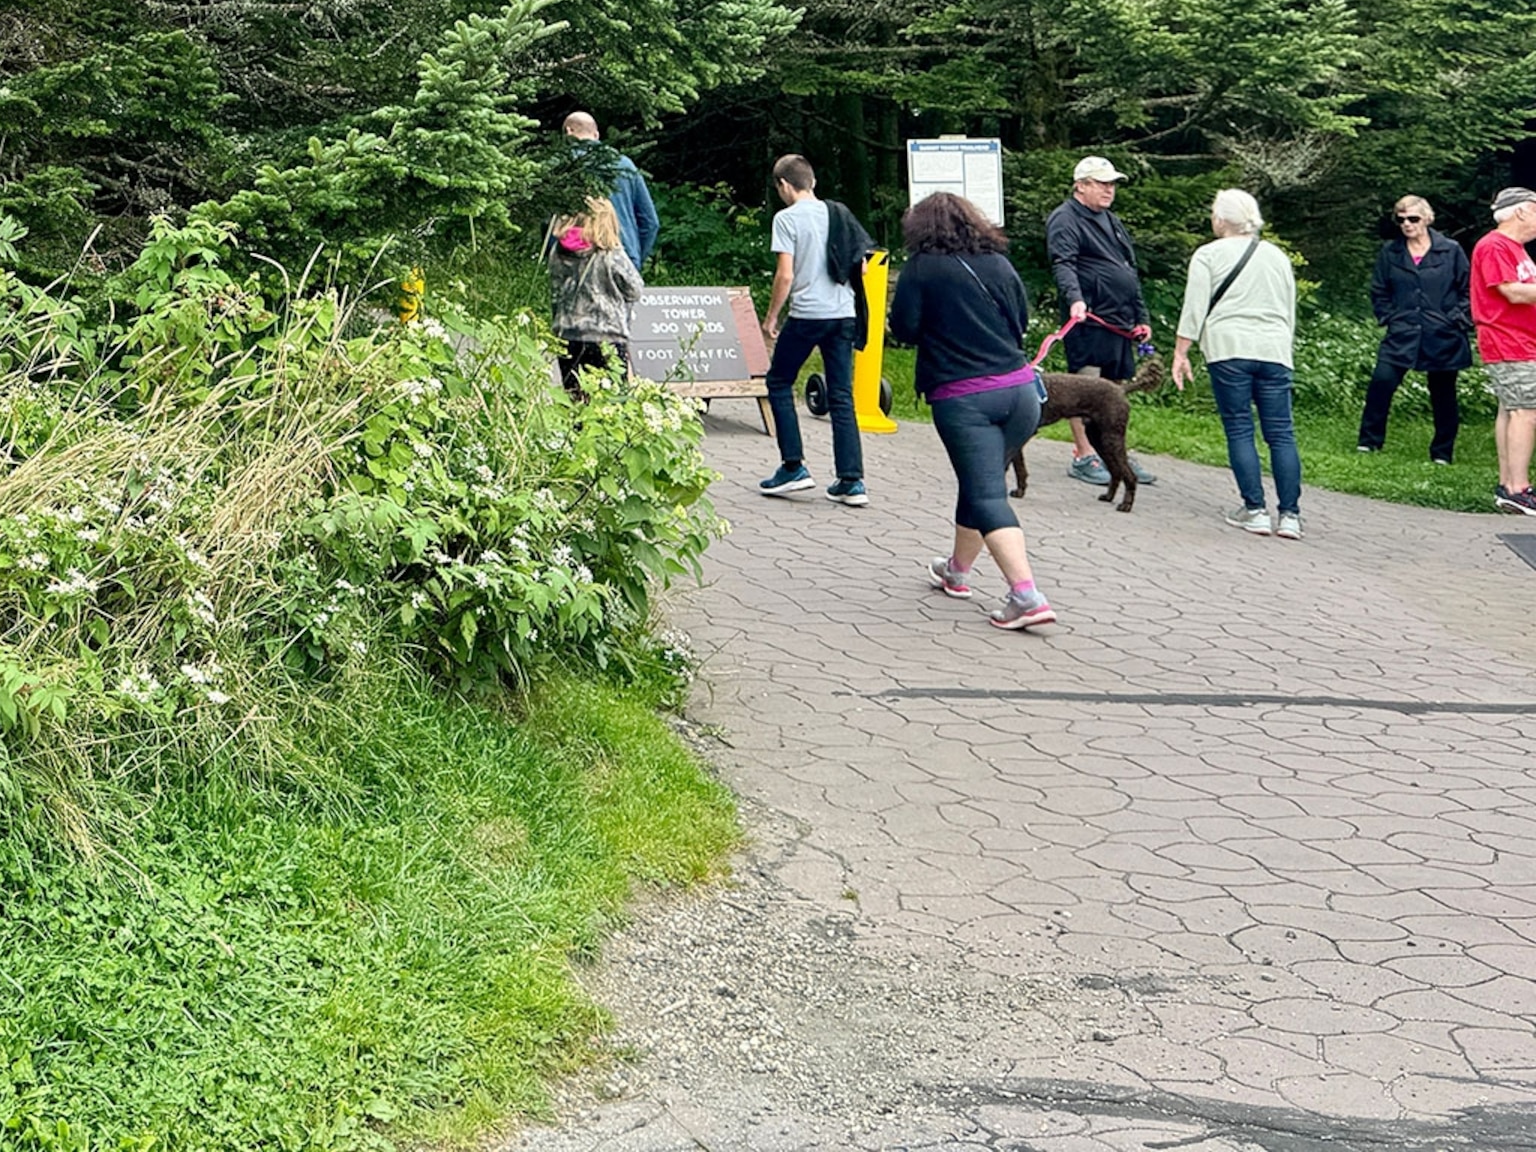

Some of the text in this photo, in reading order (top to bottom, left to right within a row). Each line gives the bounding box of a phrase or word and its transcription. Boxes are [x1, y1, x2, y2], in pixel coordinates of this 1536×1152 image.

[640, 295, 722, 306] OBSERVATION
[662, 309, 706, 319] TOWER
[651, 322, 725, 334] 300 YARDS
[638, 350, 673, 360] FOOT
